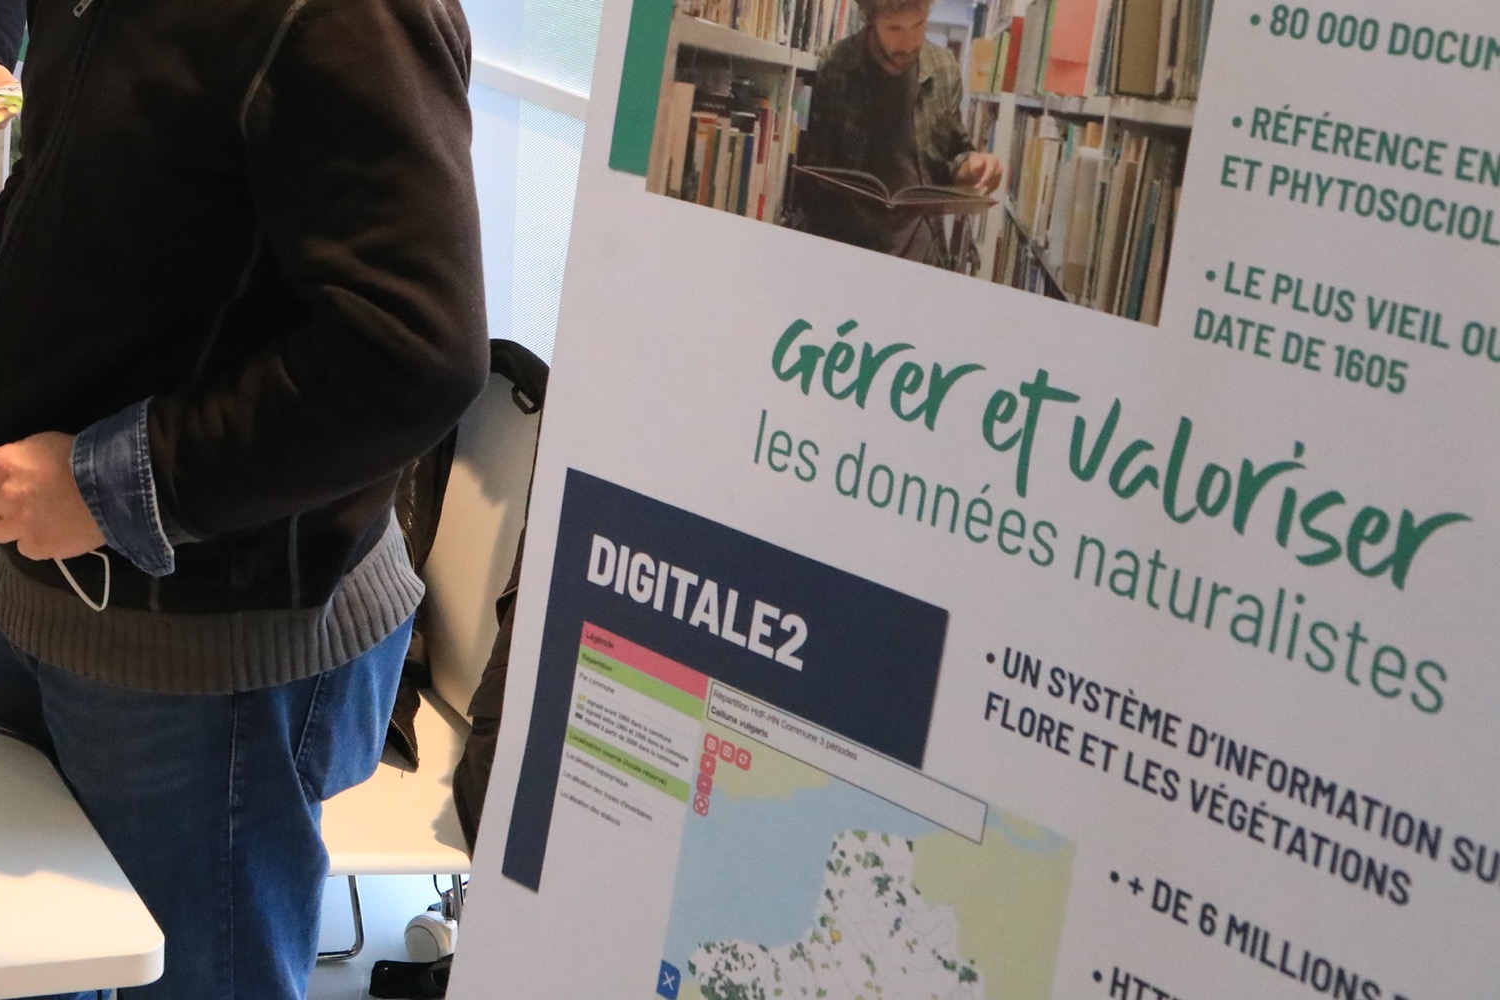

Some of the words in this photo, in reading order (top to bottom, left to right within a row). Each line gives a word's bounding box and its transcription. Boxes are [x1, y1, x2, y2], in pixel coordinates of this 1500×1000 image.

[1269, 4, 1309, 40] 80
[1317, 12, 1380, 51] 000
[1250, 104, 1448, 176] RÉFÉRENCE
[1455, 146, 1500, 188] EN
[1220, 155, 1262, 191] ET
[1269, 164, 1500, 246] PHYTOSOCIOL
[1194, 307, 1276, 358] DATE
[1281, 331, 1325, 372] DE
[1334, 345, 1408, 394] 1605
[1224, 262, 1265, 300] LE
[1271, 273, 1356, 323] PLUS
[1367, 295, 1449, 349] VIEIL
[770, 318, 987, 432] Gérer
[981, 368, 1080, 498] et
[586, 533, 810, 671] DIGITALE2
[753, 409, 817, 482] les
[834, 441, 1058, 568] données
[1075, 533, 1448, 715] naturalistes
[710, 705, 739, 723] Calluna
[739, 719, 770, 738] vulgaris
[780, 720, 819, 742] Commune
[1002, 647, 1042, 689] UN
[1047, 665, 1182, 748] SYSTÈME
[1187, 724, 1442, 861] D'INFORMATION
[1450, 836, 1500, 884] SU
[984, 691, 1074, 755] FLORE
[1079, 732, 1119, 773] ET
[1123, 751, 1181, 802] LES
[1189, 777, 1412, 906] VÉGÉTATIONS
[1128, 876, 1145, 895] +
[1151, 878, 1191, 926] DE
[1199, 903, 1218, 936] 6
[1225, 914, 1381, 1000] MILLIONS
